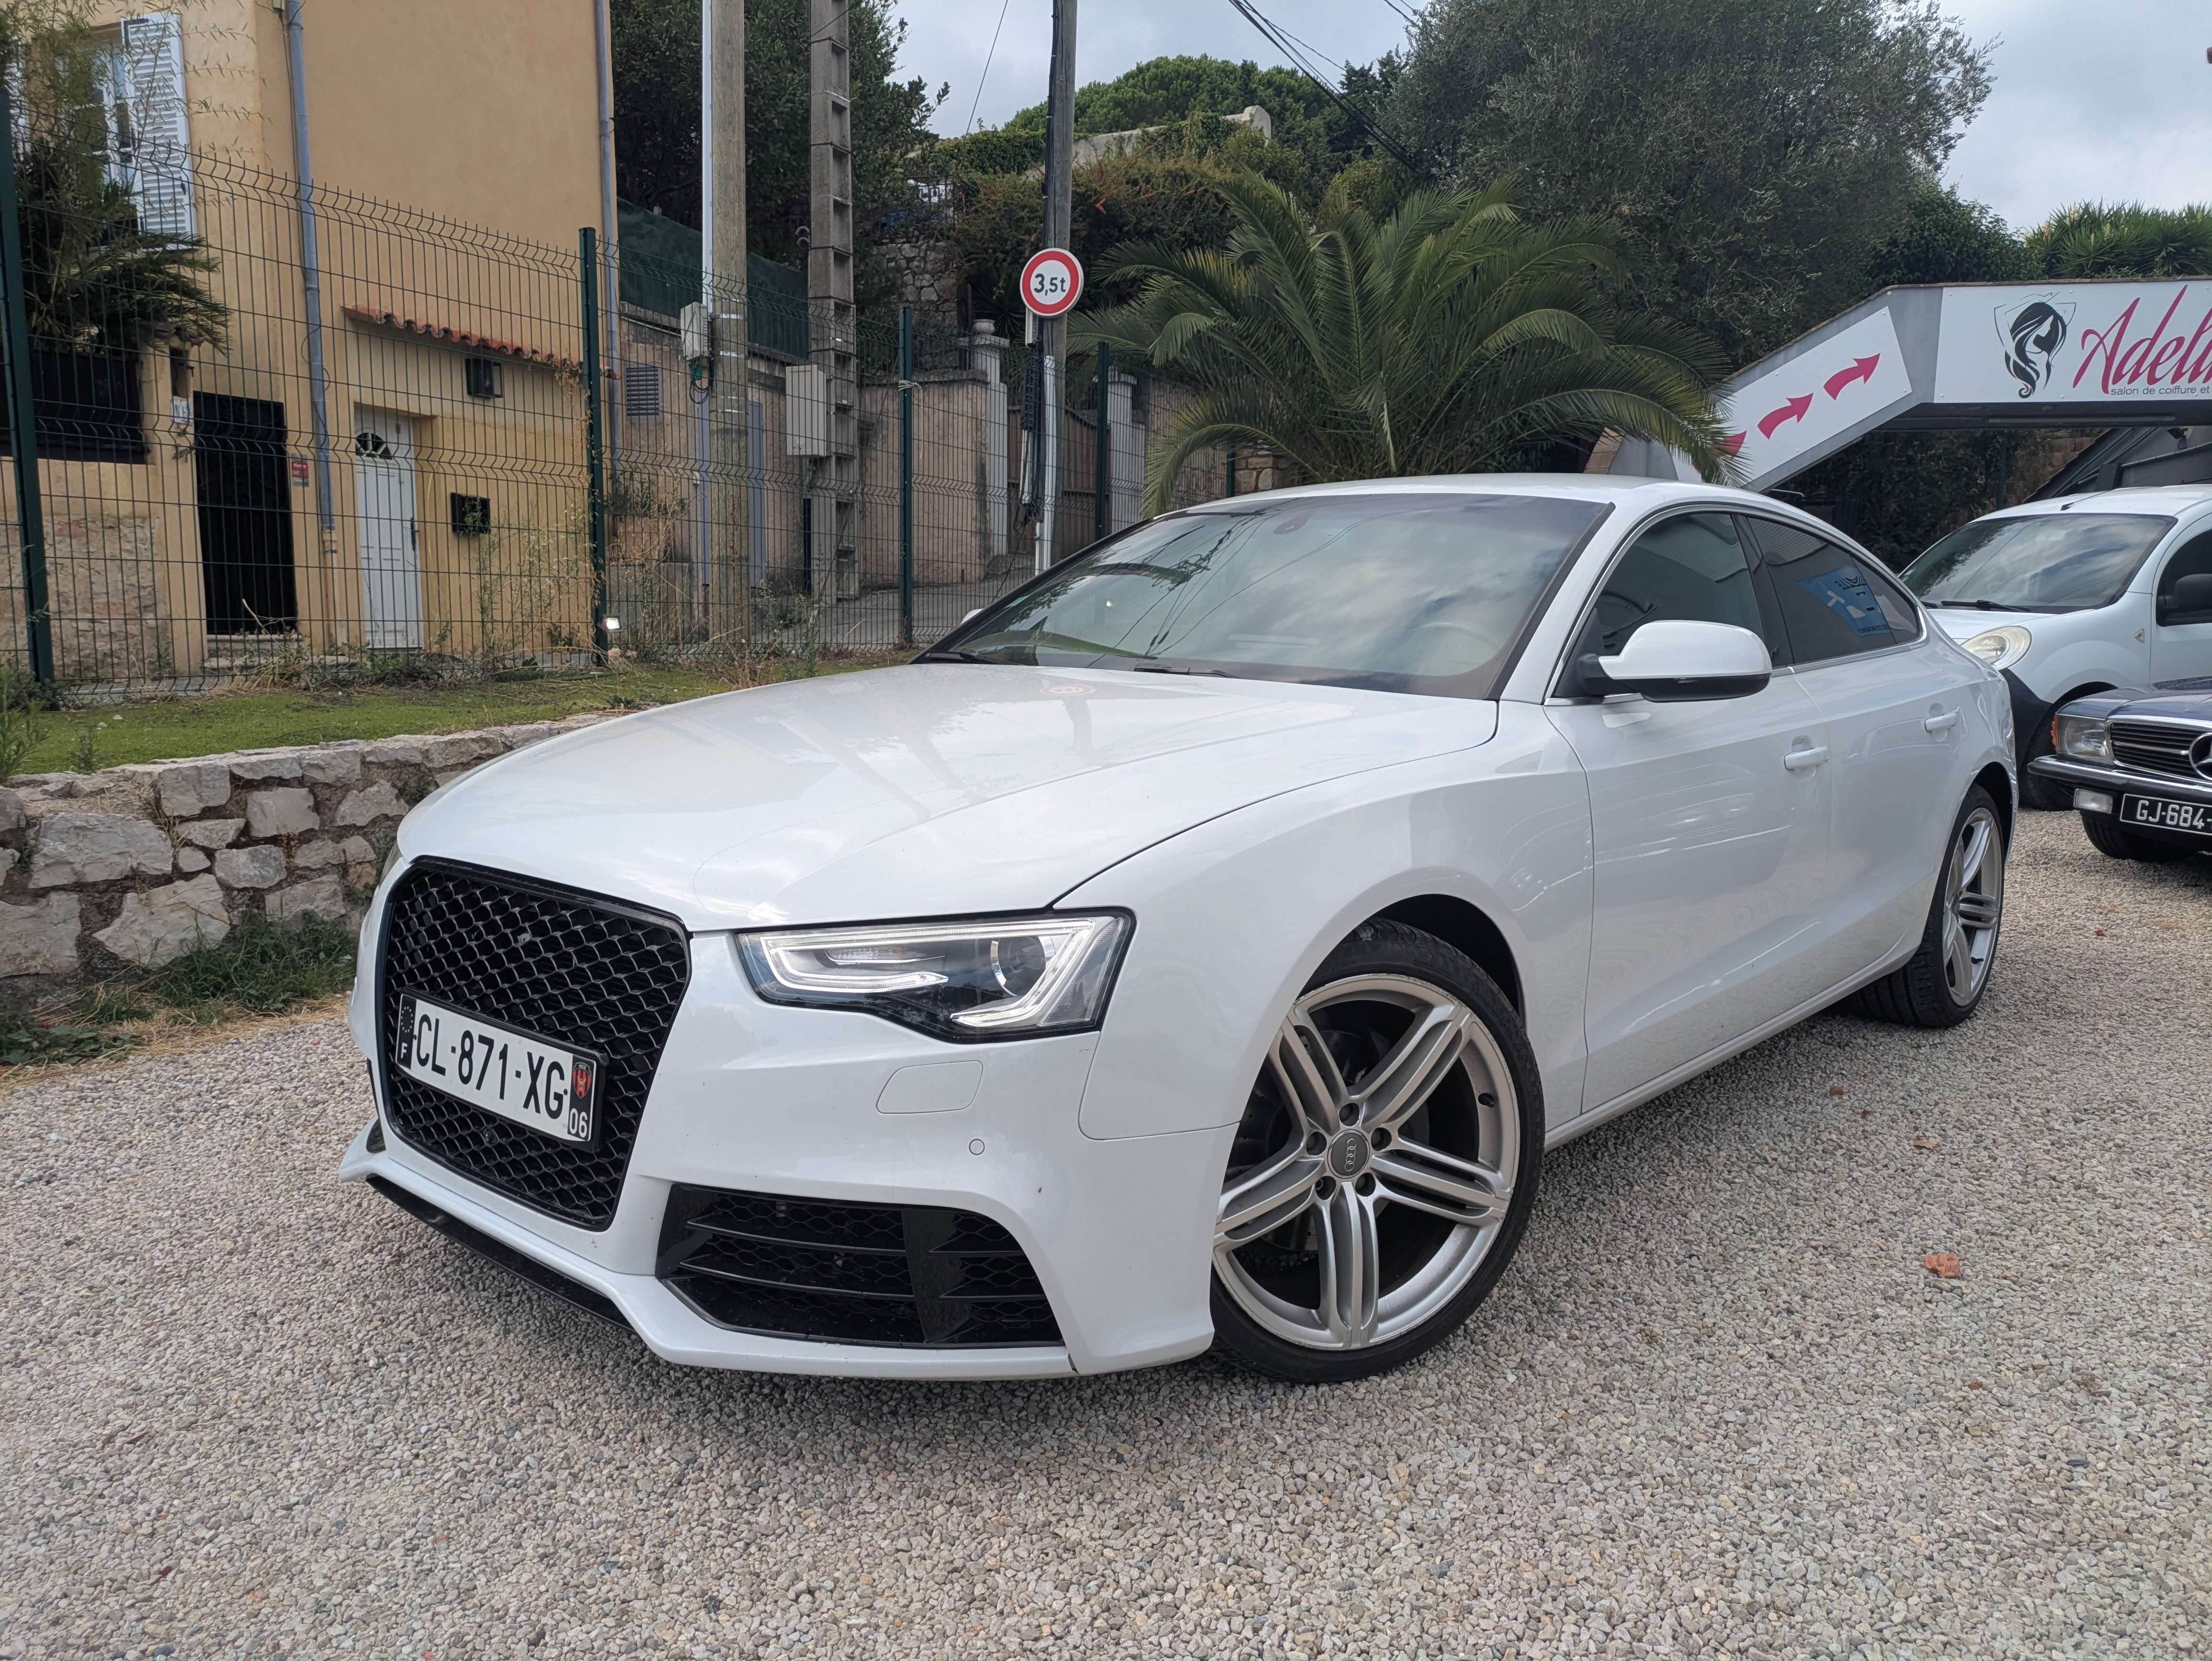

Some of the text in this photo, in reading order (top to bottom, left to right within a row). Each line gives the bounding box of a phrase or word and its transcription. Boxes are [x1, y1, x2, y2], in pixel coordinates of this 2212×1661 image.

[1033, 273, 1066, 296] 3,5t
[2073, 284, 2212, 394] Adeli
[2111, 385, 2210, 395] salon de coiffure et
[2136, 800, 2212, 829] GJ-684-
[400, 1042, 408, 1059] F
[416, 1013, 565, 1120] CL-871-XG
[569, 1107, 588, 1138] 06
